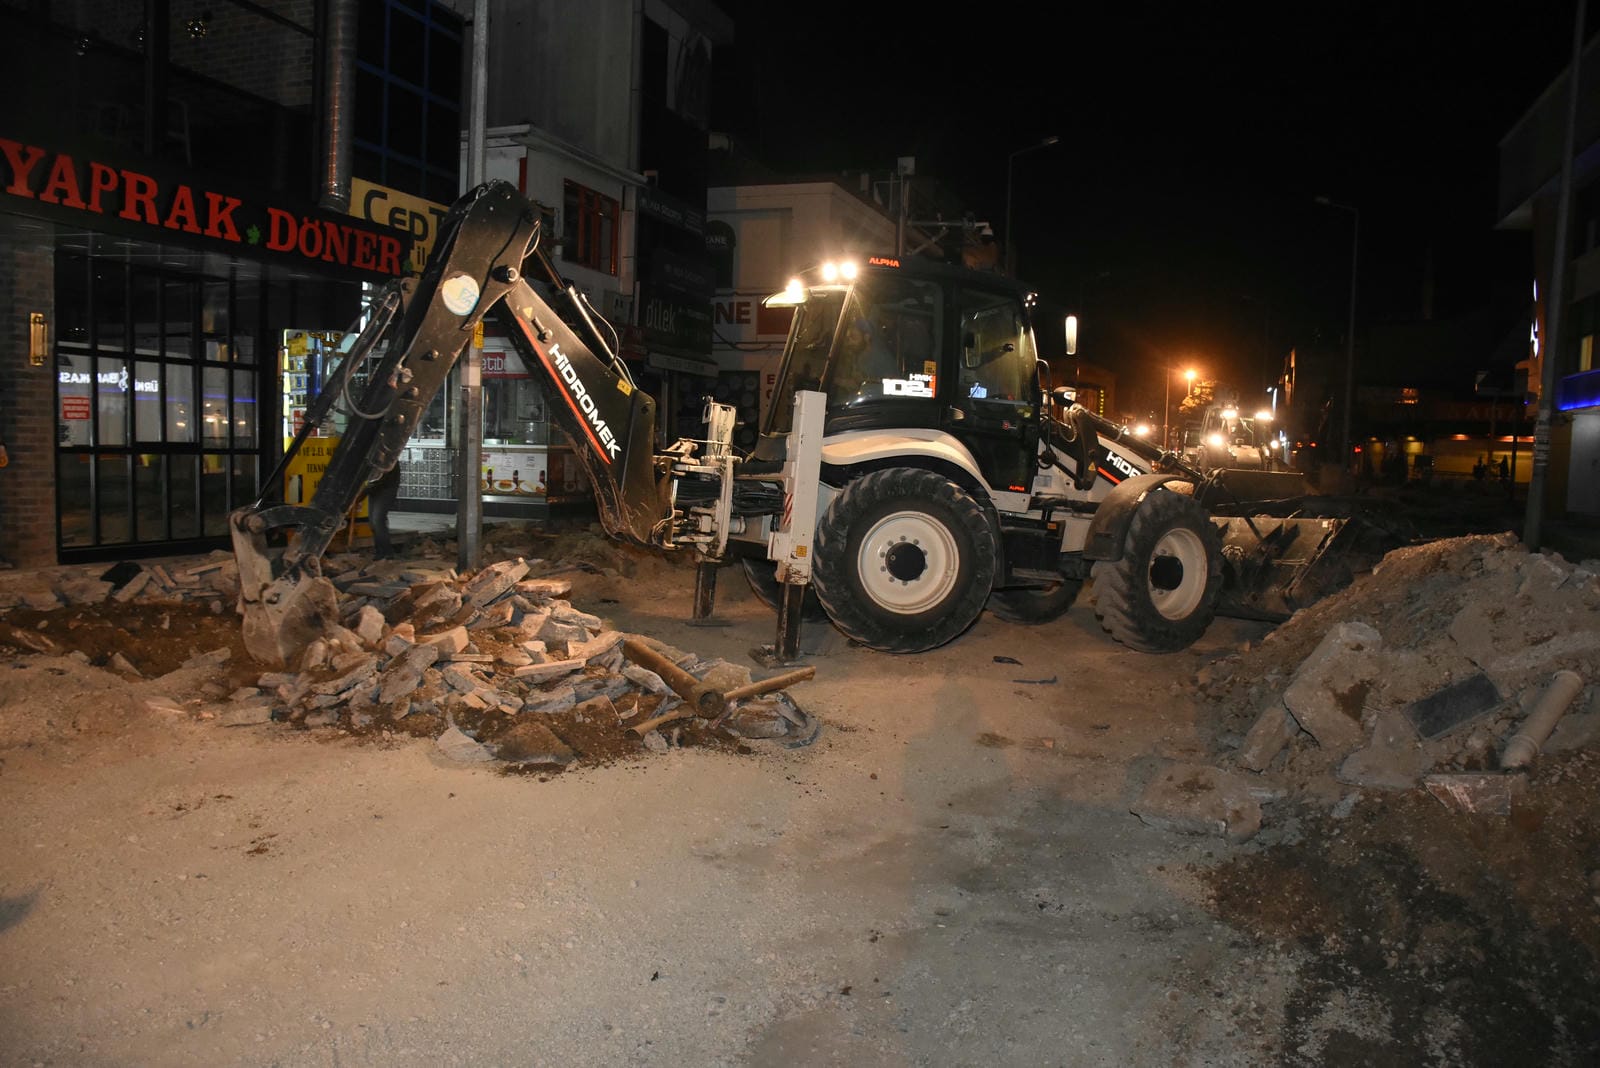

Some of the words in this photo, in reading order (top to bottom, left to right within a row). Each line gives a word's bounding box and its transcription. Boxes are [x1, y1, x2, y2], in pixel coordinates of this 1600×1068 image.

[0, 137, 243, 243] YAPRAK
[266, 207, 402, 276] DÖNER
[869, 257, 901, 268] ALPHA
[909, 373, 933, 382] HMK
[1008, 484, 1026, 493] ALPHA
